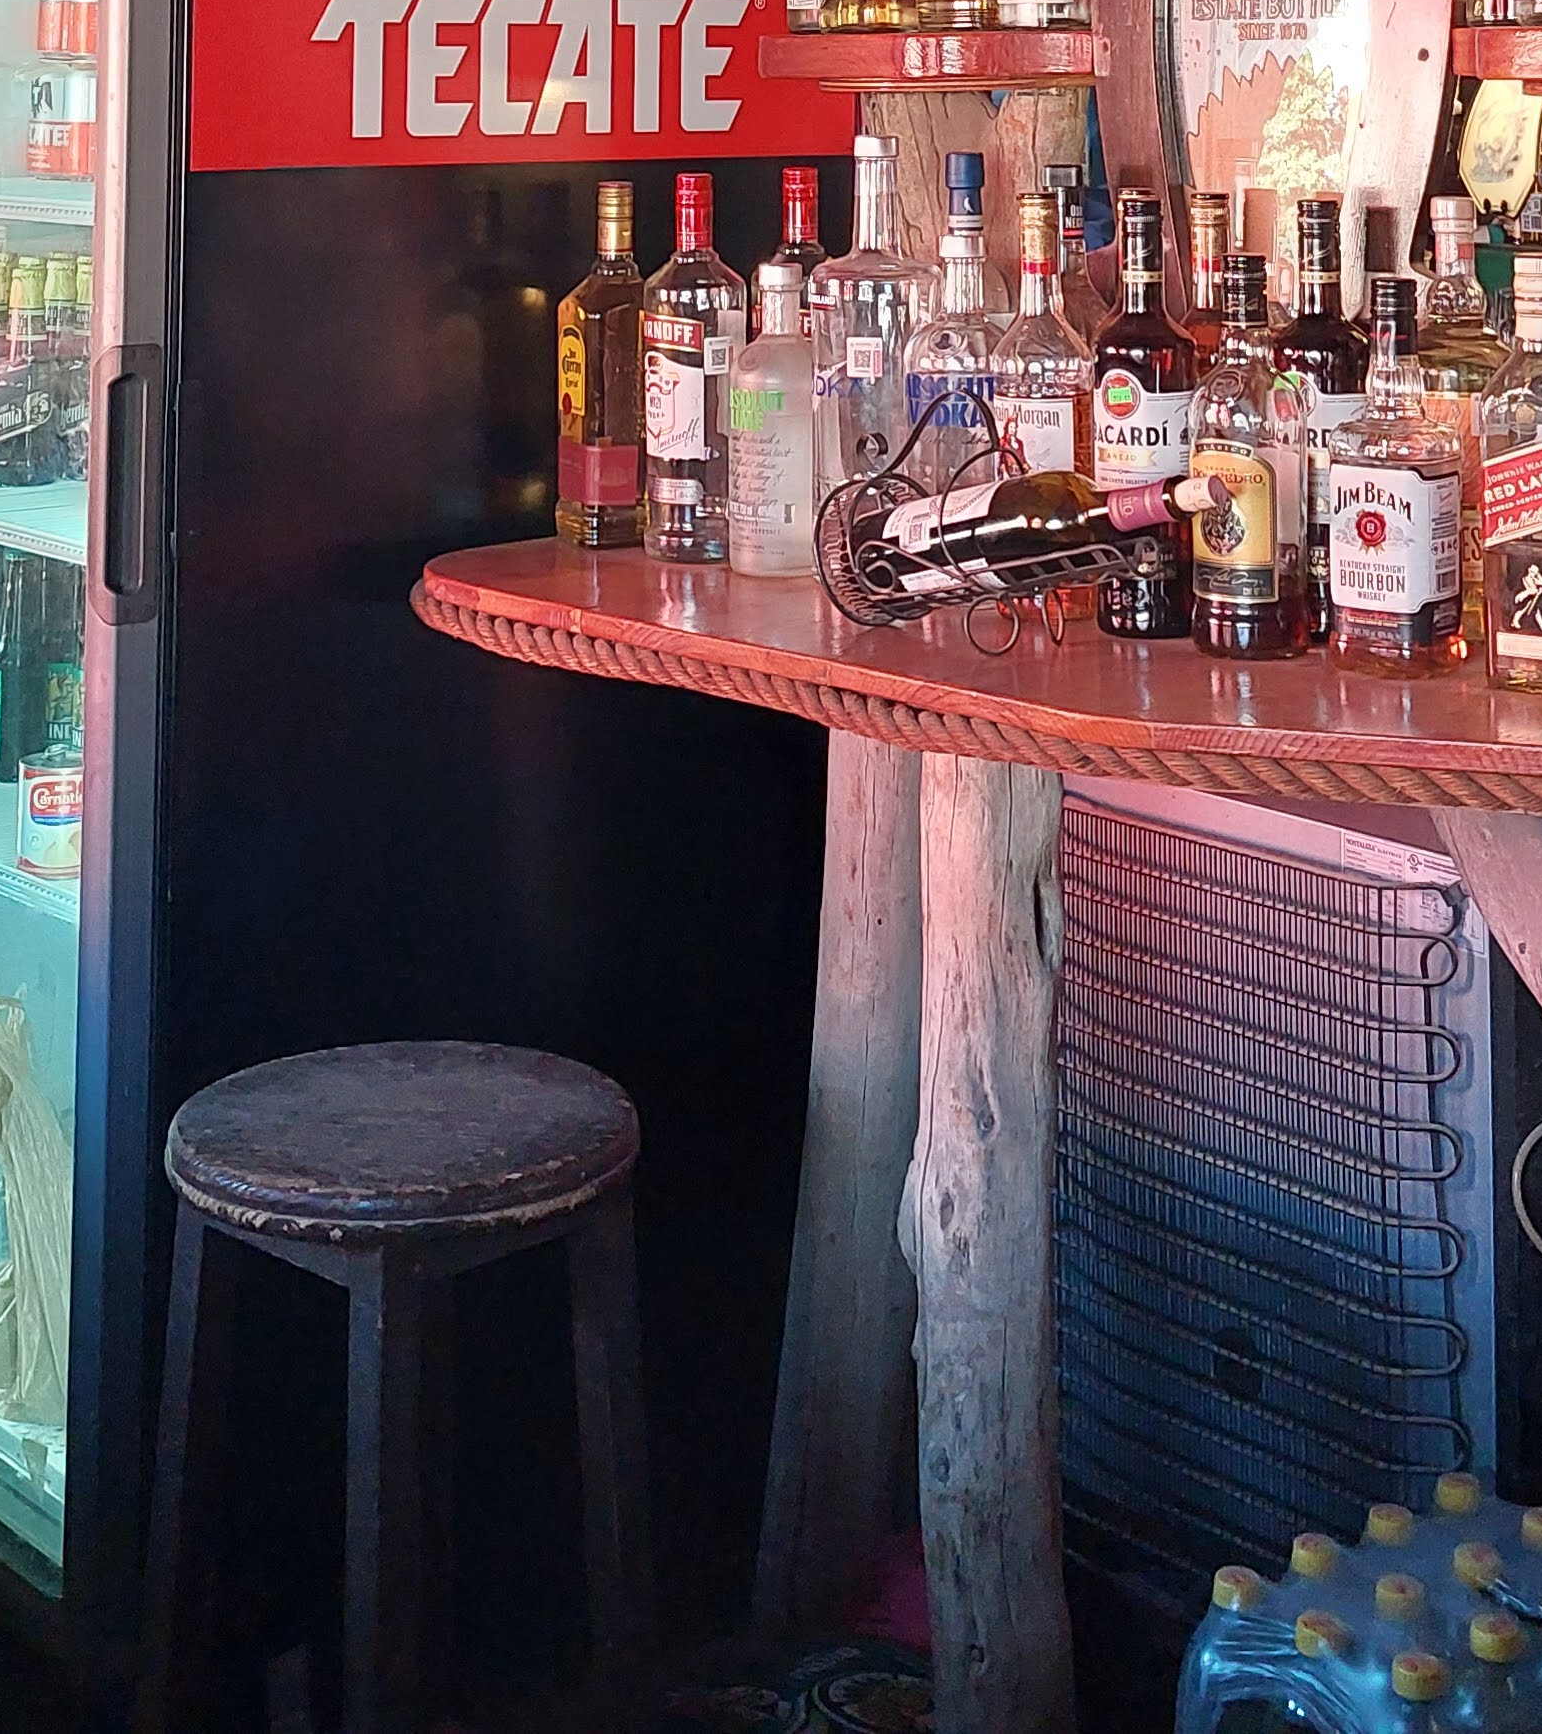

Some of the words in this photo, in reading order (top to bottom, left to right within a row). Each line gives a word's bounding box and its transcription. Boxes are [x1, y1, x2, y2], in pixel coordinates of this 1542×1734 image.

[1238, 22, 1275, 40] SINCE
[644, 320, 695, 345] RNOFF
[1011, 403, 1061, 429] Morgan
[1487, 466, 1526, 486] JOHNNIE
[1334, 485, 1360, 515] JIM
[1363, 481, 1413, 523] BEAM
[1483, 483, 1516, 504] RED
[1339, 559, 1371, 571] KENTUCKY
[1372, 563, 1406, 574] STRAIGHT
[1340, 569, 1406, 594] BOURBON
[1357, 590, 1386, 602] WHISKEY
